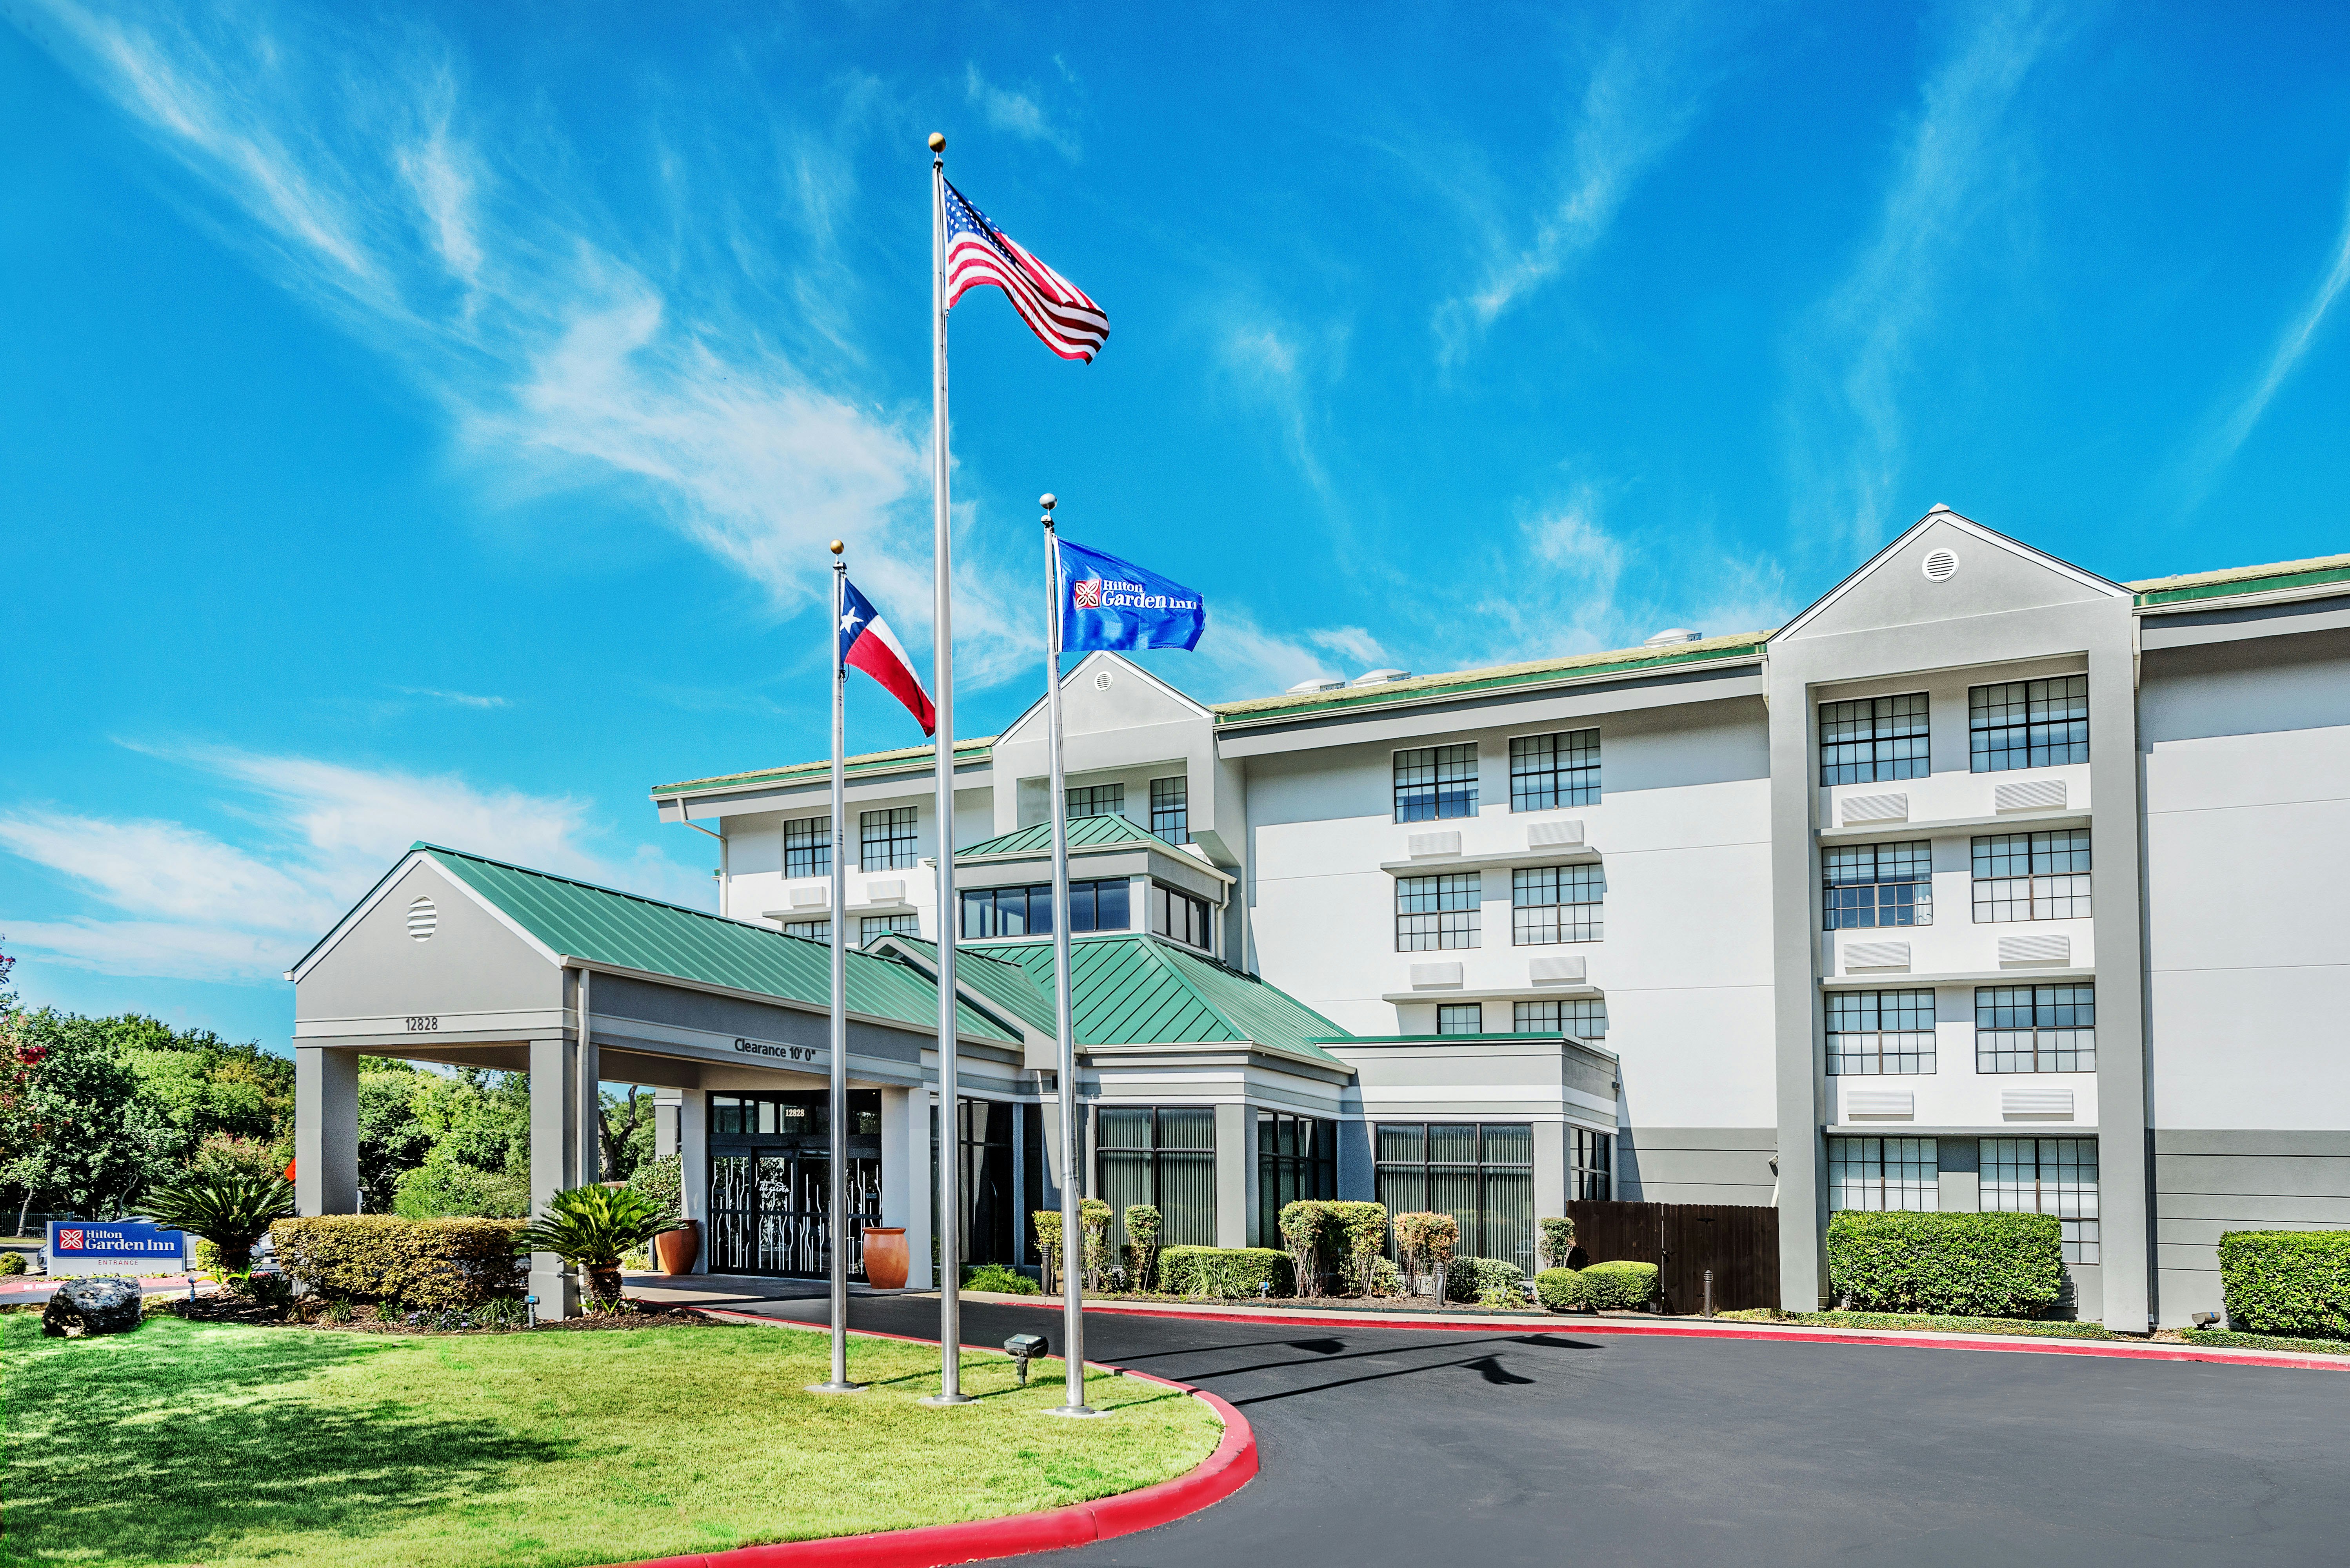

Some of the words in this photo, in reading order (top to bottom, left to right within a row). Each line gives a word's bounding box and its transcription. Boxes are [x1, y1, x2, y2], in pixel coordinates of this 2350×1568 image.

[1103, 579, 1143, 592] Hilton
[1101, 590, 1167, 608] Garden
[1169, 597, 1197, 609] Inn
[405, 1017, 438, 1031] 12828
[734, 1038, 786, 1058] Clearance
[789, 1047, 802, 1060] 10'
[805, 1048, 816, 1061] 0"
[759, 1181, 771, 1191] the
[765, 1182, 790, 1198] garden
[86, 1230, 122, 1238] Hilton
[85, 1239, 145, 1250] Garden
[147, 1239, 175, 1250] Inn
